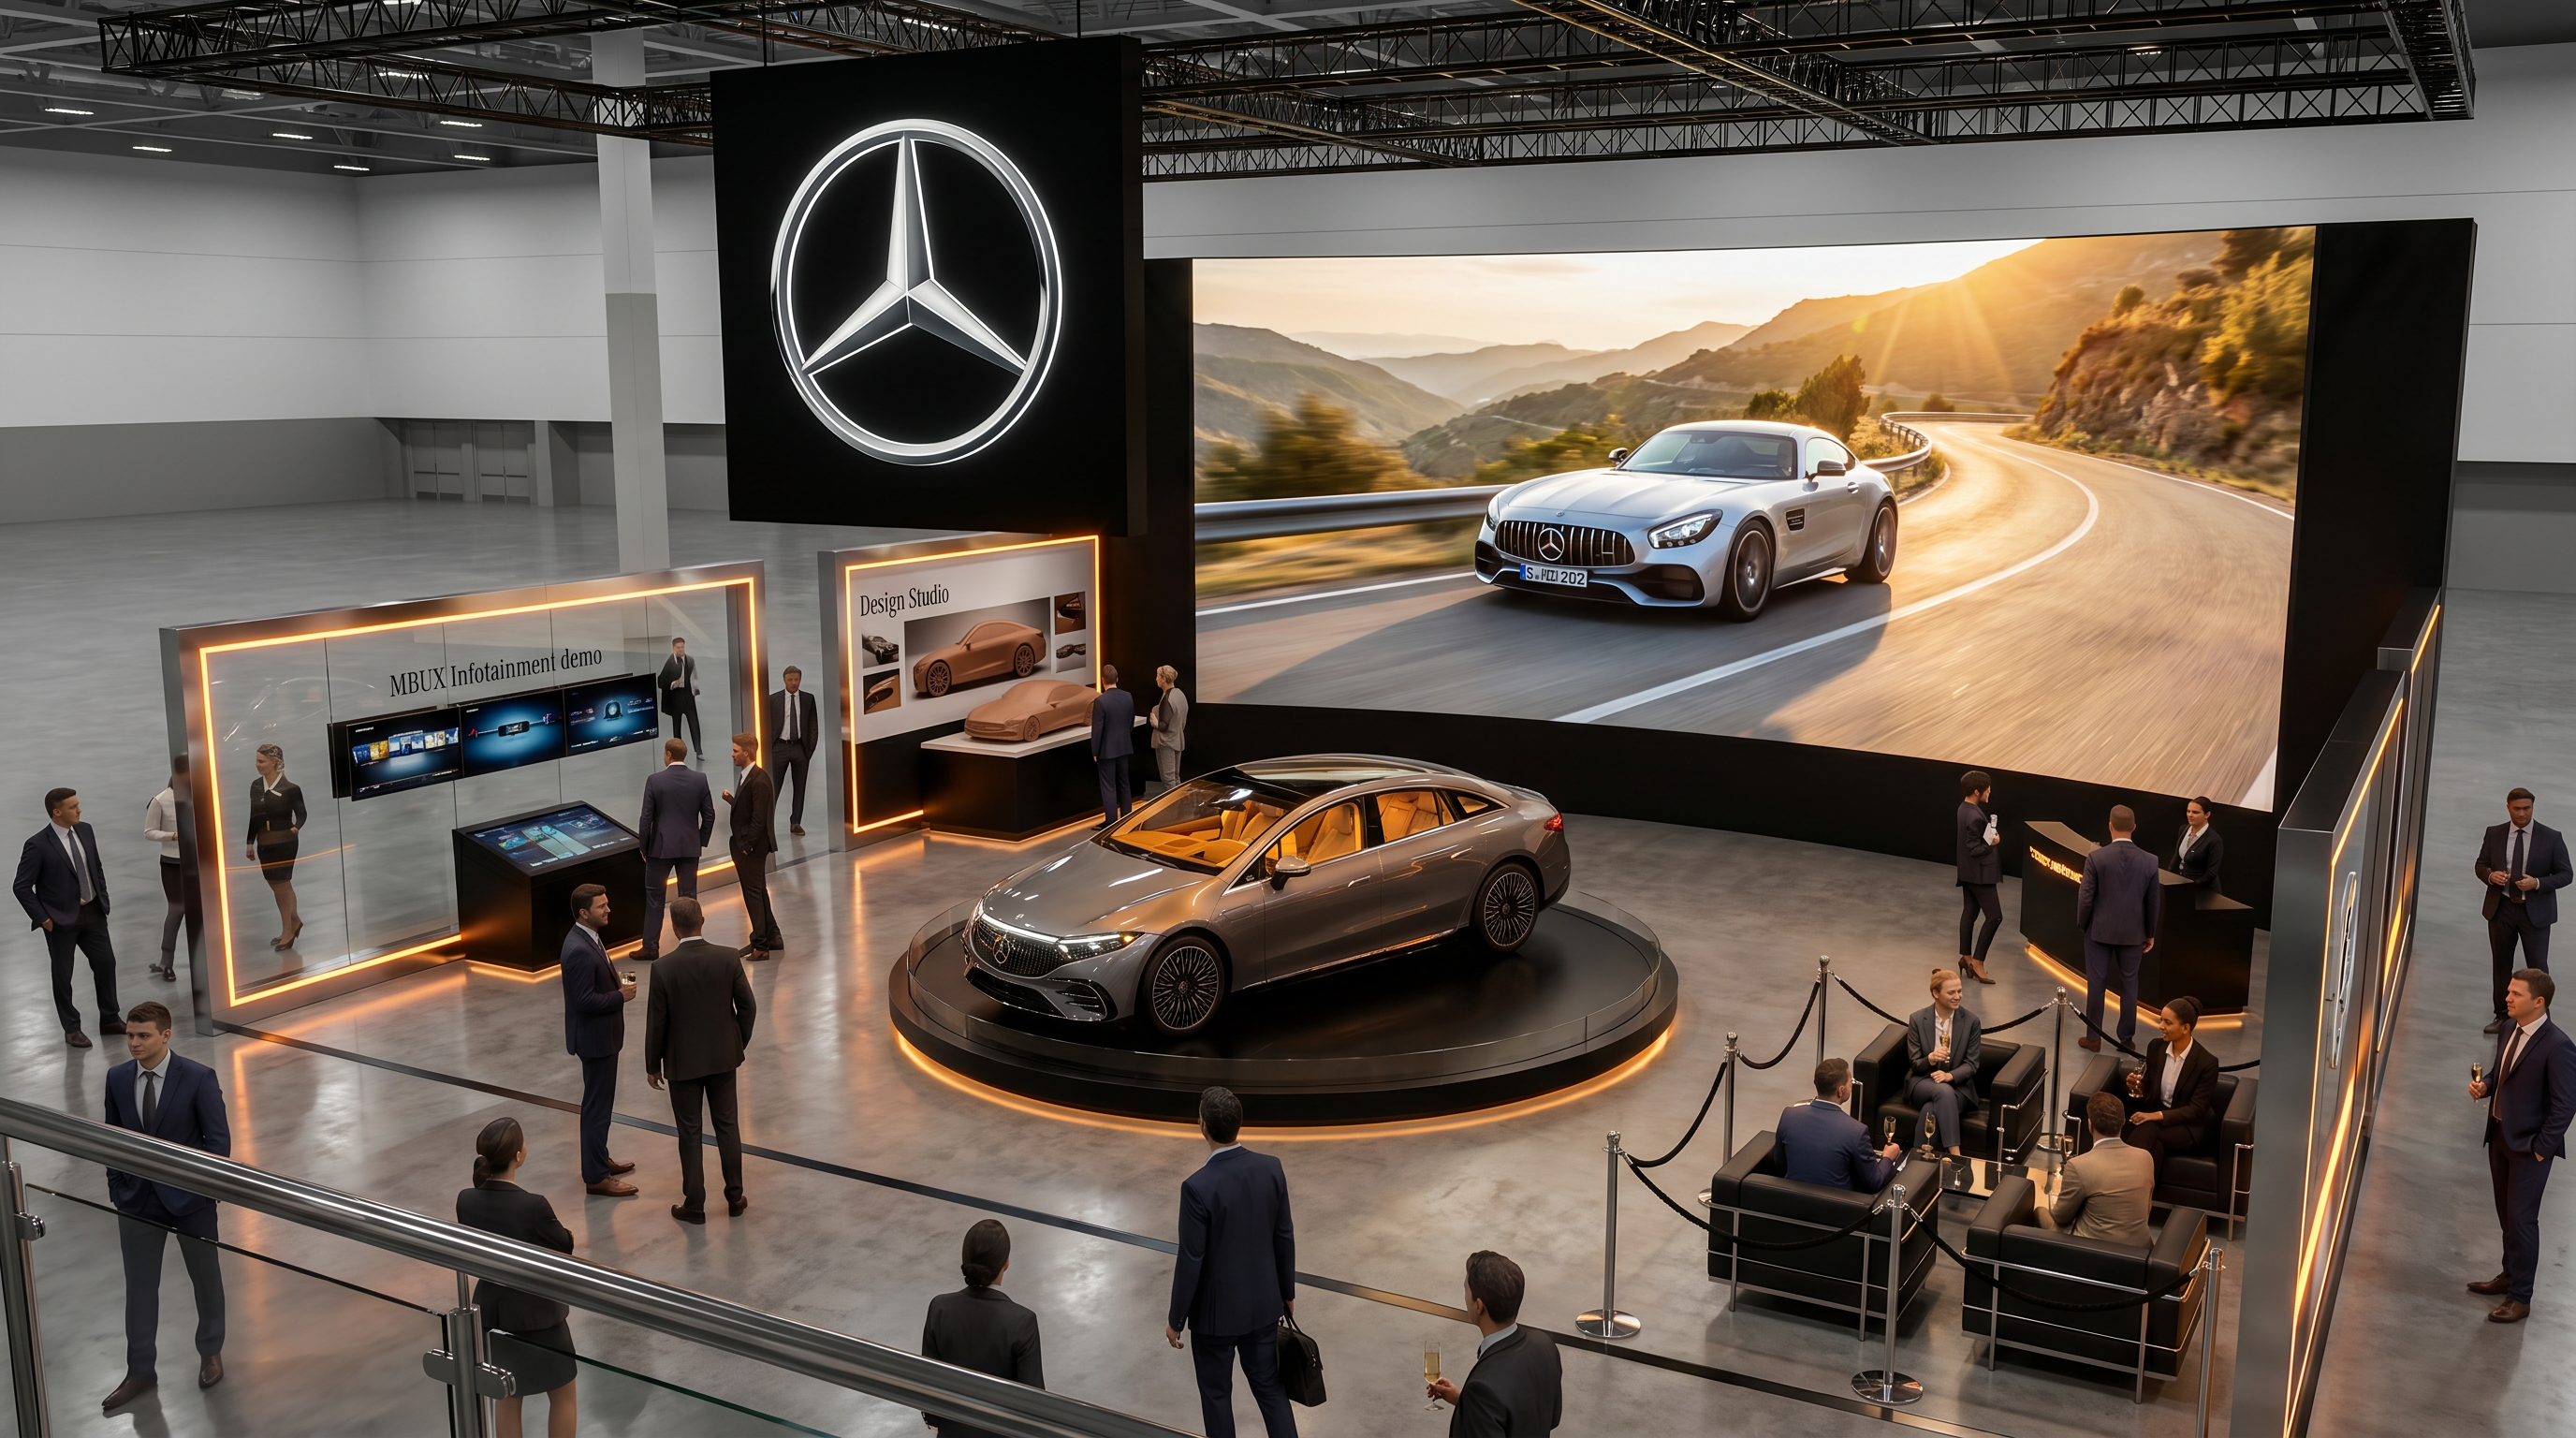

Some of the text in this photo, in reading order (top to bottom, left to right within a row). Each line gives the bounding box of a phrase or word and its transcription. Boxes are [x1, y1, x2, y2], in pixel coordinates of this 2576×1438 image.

[1527, 566, 1534, 580] S
[1560, 571, 1586, 585] 202
[860, 583, 949, 619] Design Studio
[389, 648, 602, 697] MBUX Infotainment demo
